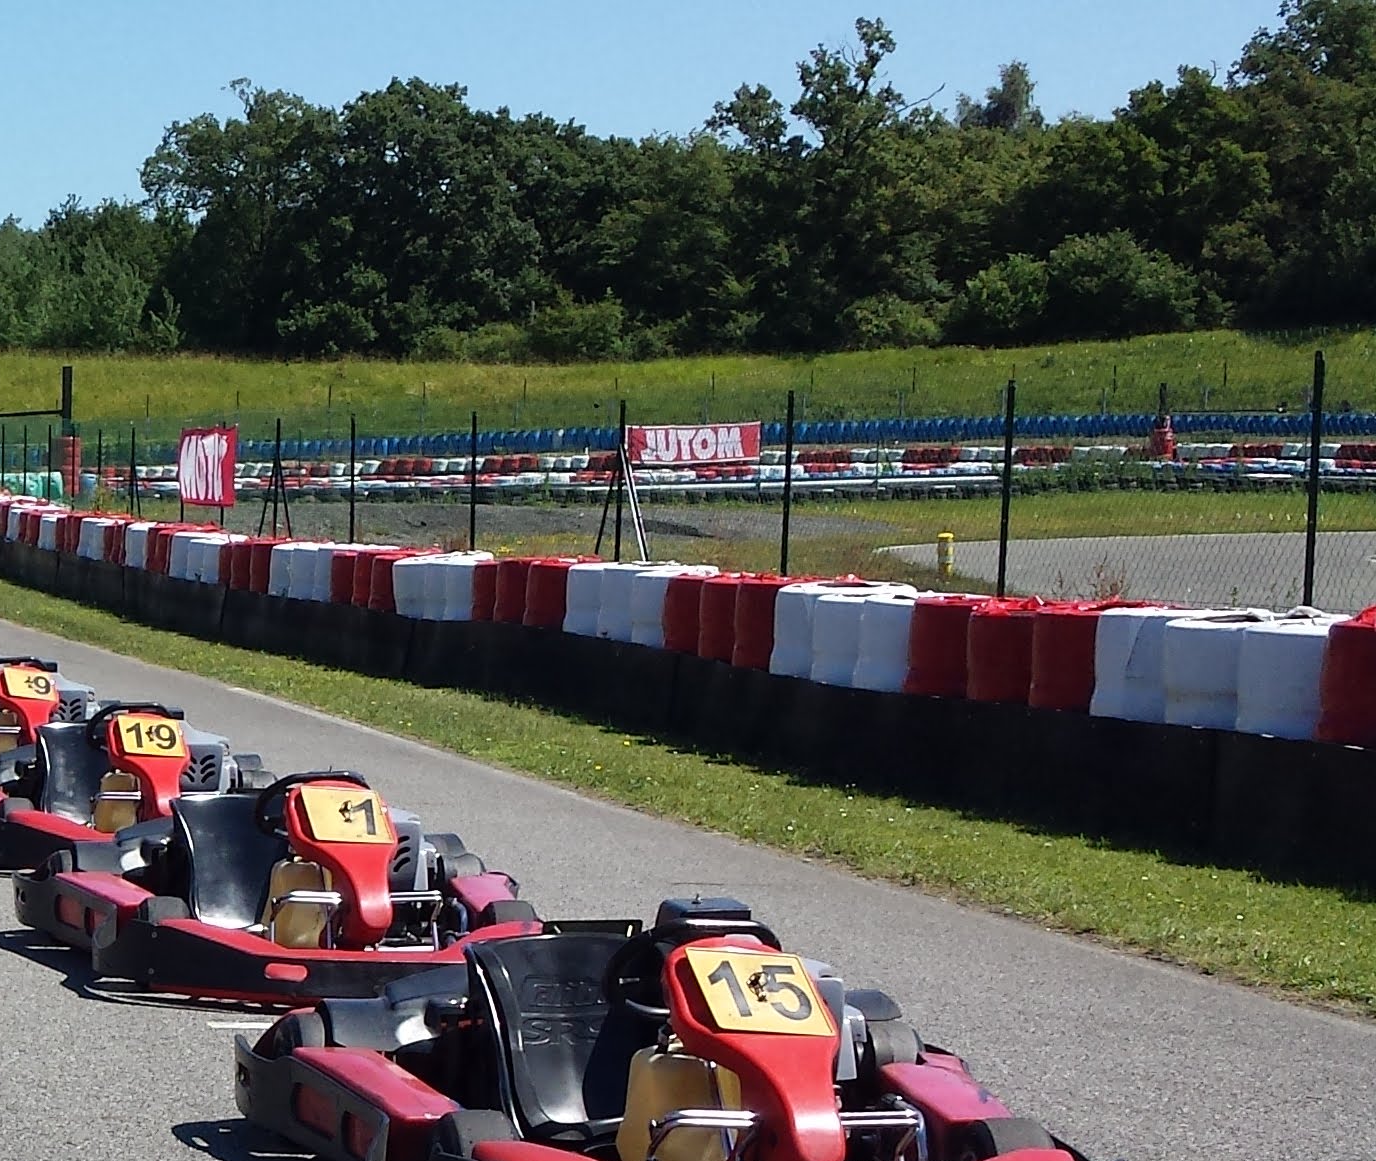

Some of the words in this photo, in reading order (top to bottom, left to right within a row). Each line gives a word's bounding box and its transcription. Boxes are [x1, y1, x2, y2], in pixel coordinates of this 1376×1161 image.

[179, 433, 228, 502] MOTU
[125, 722, 177, 750] 19
[351, 798, 377, 835] 1
[707, 960, 813, 1021] 15
